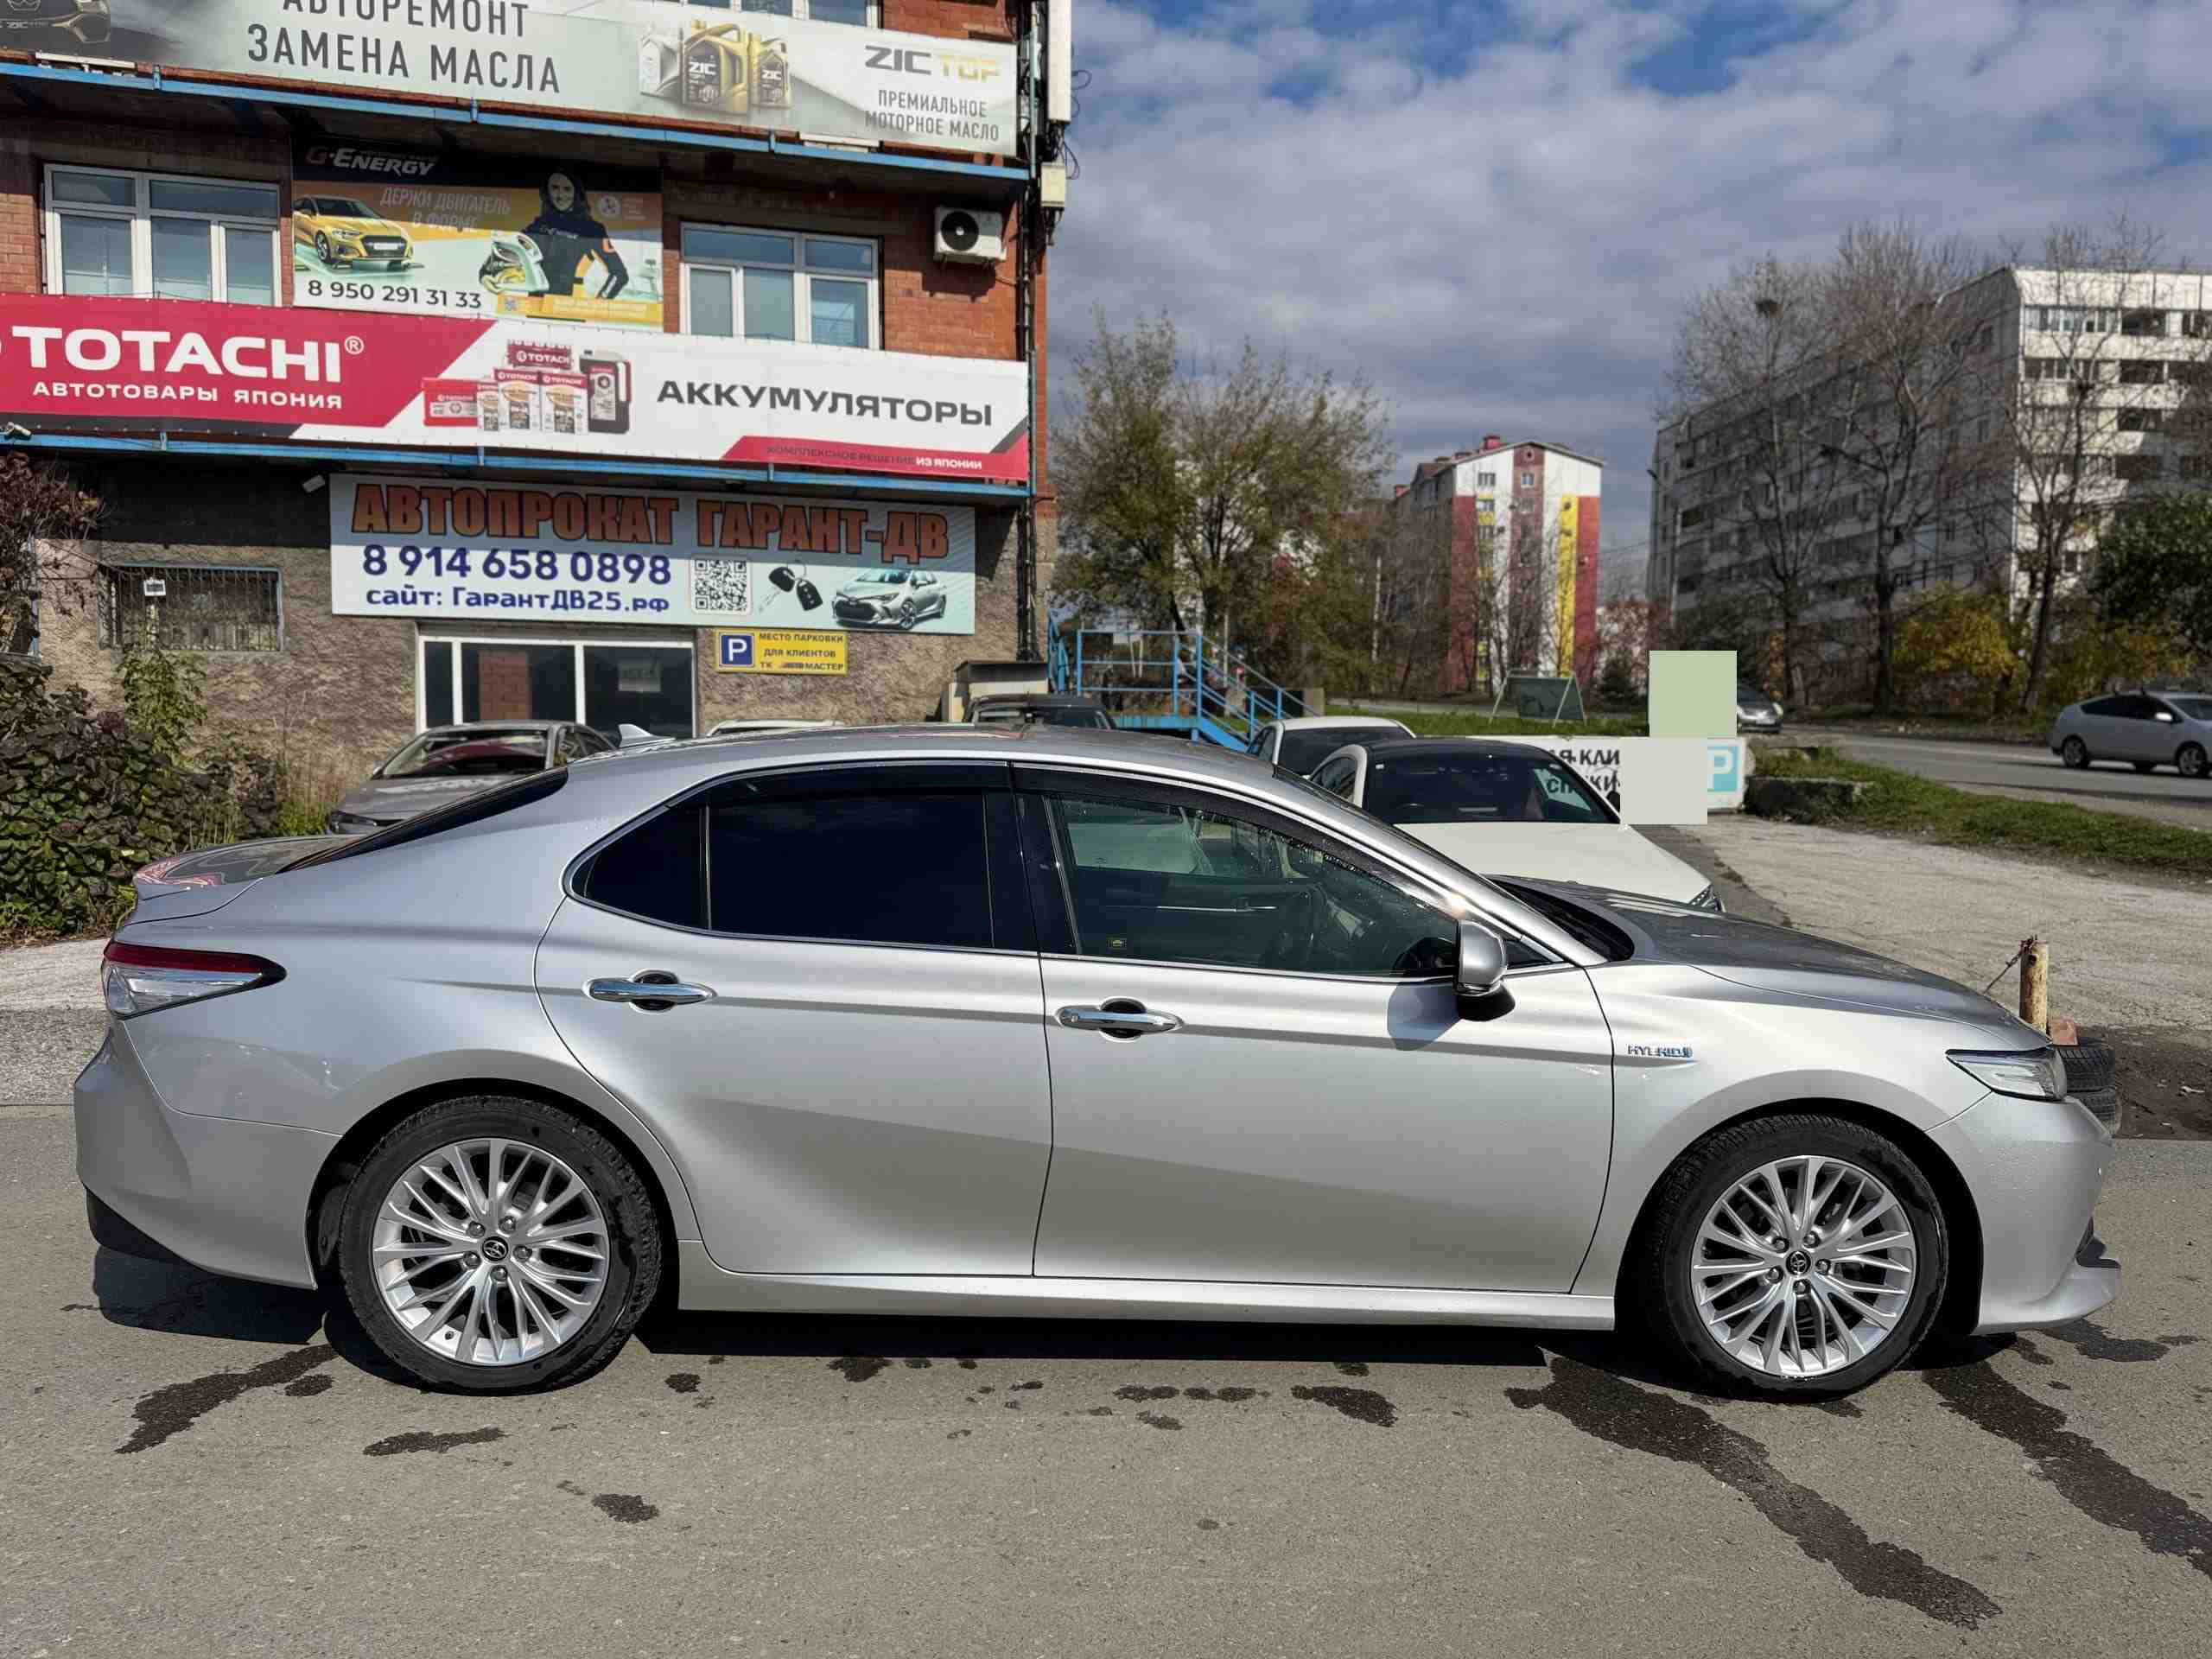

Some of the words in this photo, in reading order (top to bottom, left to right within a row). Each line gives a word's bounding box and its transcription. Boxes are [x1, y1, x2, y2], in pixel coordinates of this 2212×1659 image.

[247, 23, 410, 78] ЗАМЕНА
[430, 44, 560, 93] МАСЛА
[689, 61, 717, 75] ZIC
[865, 45, 931, 75] ZIC
[761, 69, 782, 80] ZIC
[878, 89, 988, 118] ПРЕМИАЛЬНОЕ
[865, 111, 944, 136] МОТОРНОЕ
[950, 119, 1000, 142] МАСЛО
[379, 187, 433, 207] ДЕРЖИ
[435, 192, 512, 215] ДВИГАТЕЛЬ
[308, 280, 322, 296] 8
[330, 282, 374, 300] 950
[381, 285, 418, 303] 291
[426, 289, 448, 306] 31
[455, 291, 481, 308] 33
[33, 381, 219, 403] АВТОТОВАРЫ
[234, 388, 342, 410] ЯПОНИЯ
[657, 379, 993, 427] АККУМУЛЯТОРЫ
[766, 446, 857, 461] КОМПЛЕКСНОЕ
[916, 455, 933, 467] ИЗ
[934, 458, 983, 470] ЯПОНИИ
[352, 483, 679, 545] АВТОПРОКАТ
[696, 499, 950, 564] ГАРАНТ-ДВ
[362, 544, 388, 575] 8
[398, 544, 472, 577] 914
[482, 549, 559, 581] 658
[570, 551, 671, 585] 0898
[365, 584, 442, 607] сайт:
[452, 587, 670, 613] ГарантДВ25.рф
[759, 632, 792, 642] МЕСТО
[793, 633, 844, 643] ПАРКОВКИ
[764, 648, 785, 658] ДЛЯ
[786, 649, 836, 658] КЛИЕНТОВ
